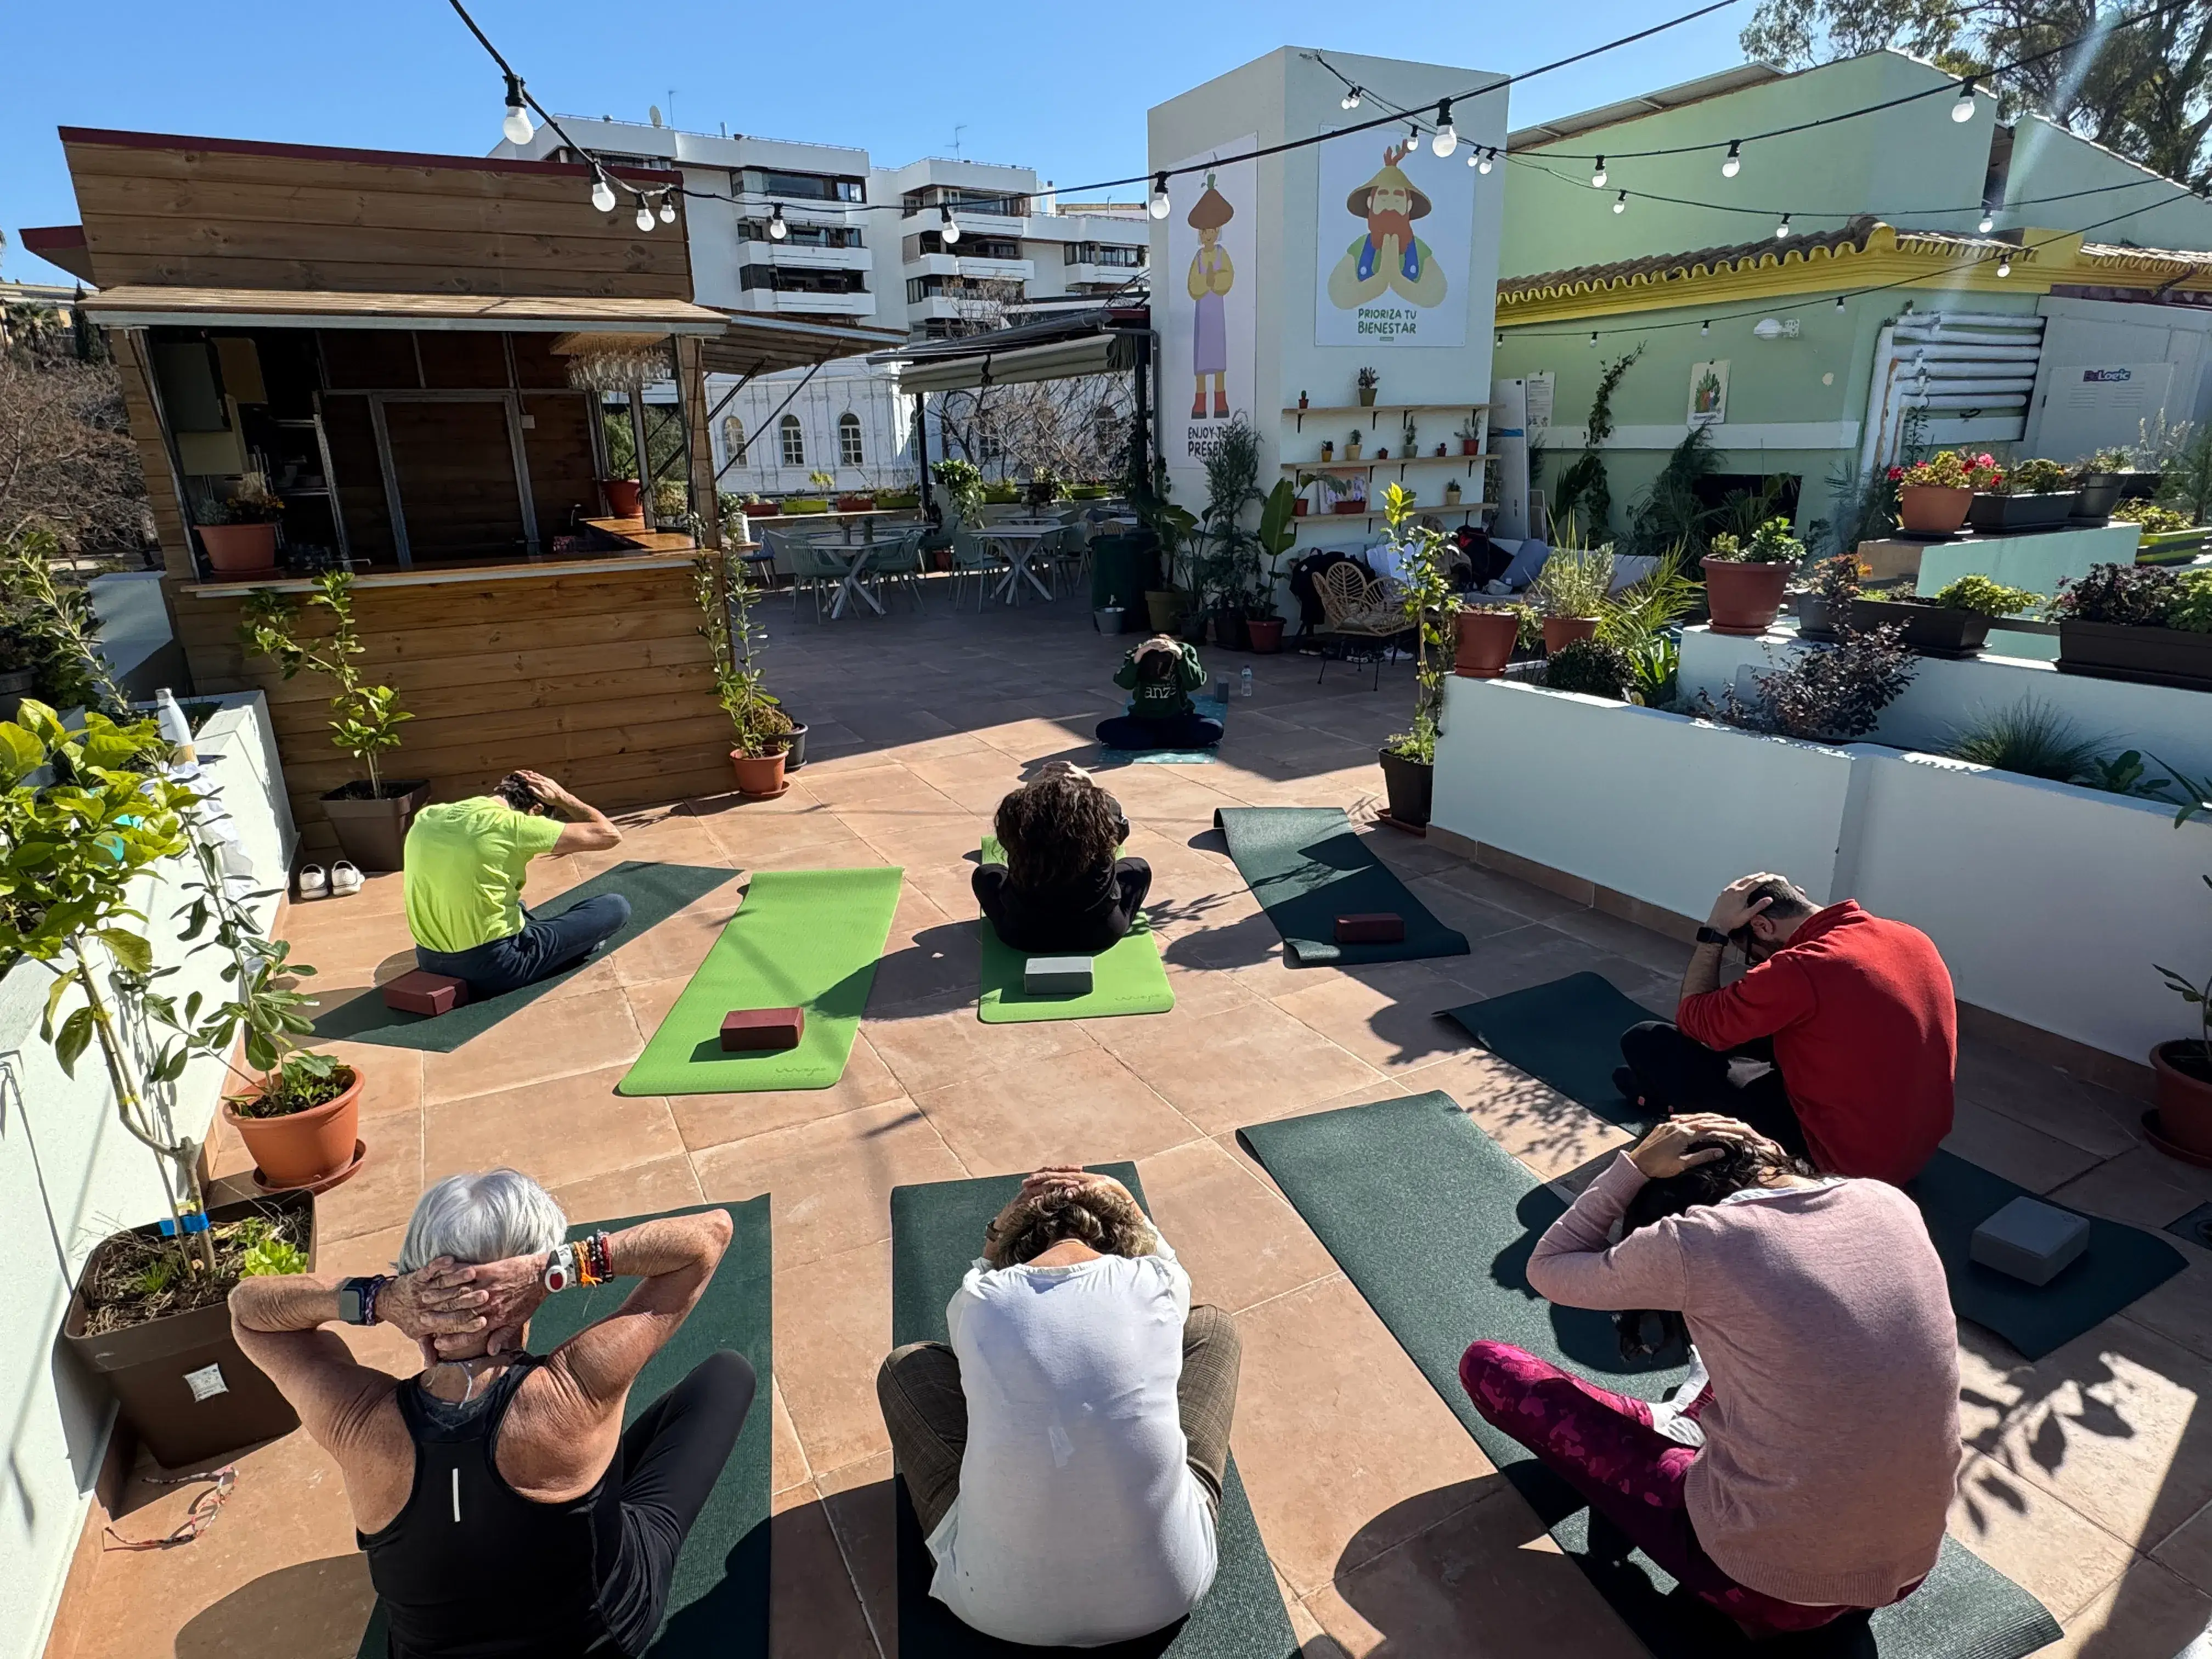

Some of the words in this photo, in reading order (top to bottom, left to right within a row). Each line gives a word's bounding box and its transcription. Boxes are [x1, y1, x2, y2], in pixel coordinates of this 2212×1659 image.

[1358, 308, 1402, 320] PRIORIZA
[1405, 309, 1417, 319] TU
[1358, 321, 1416, 334] BIENESTAR
[1188, 426, 1214, 439] ENJOY
[1188, 441, 1228, 457] PRESEN
